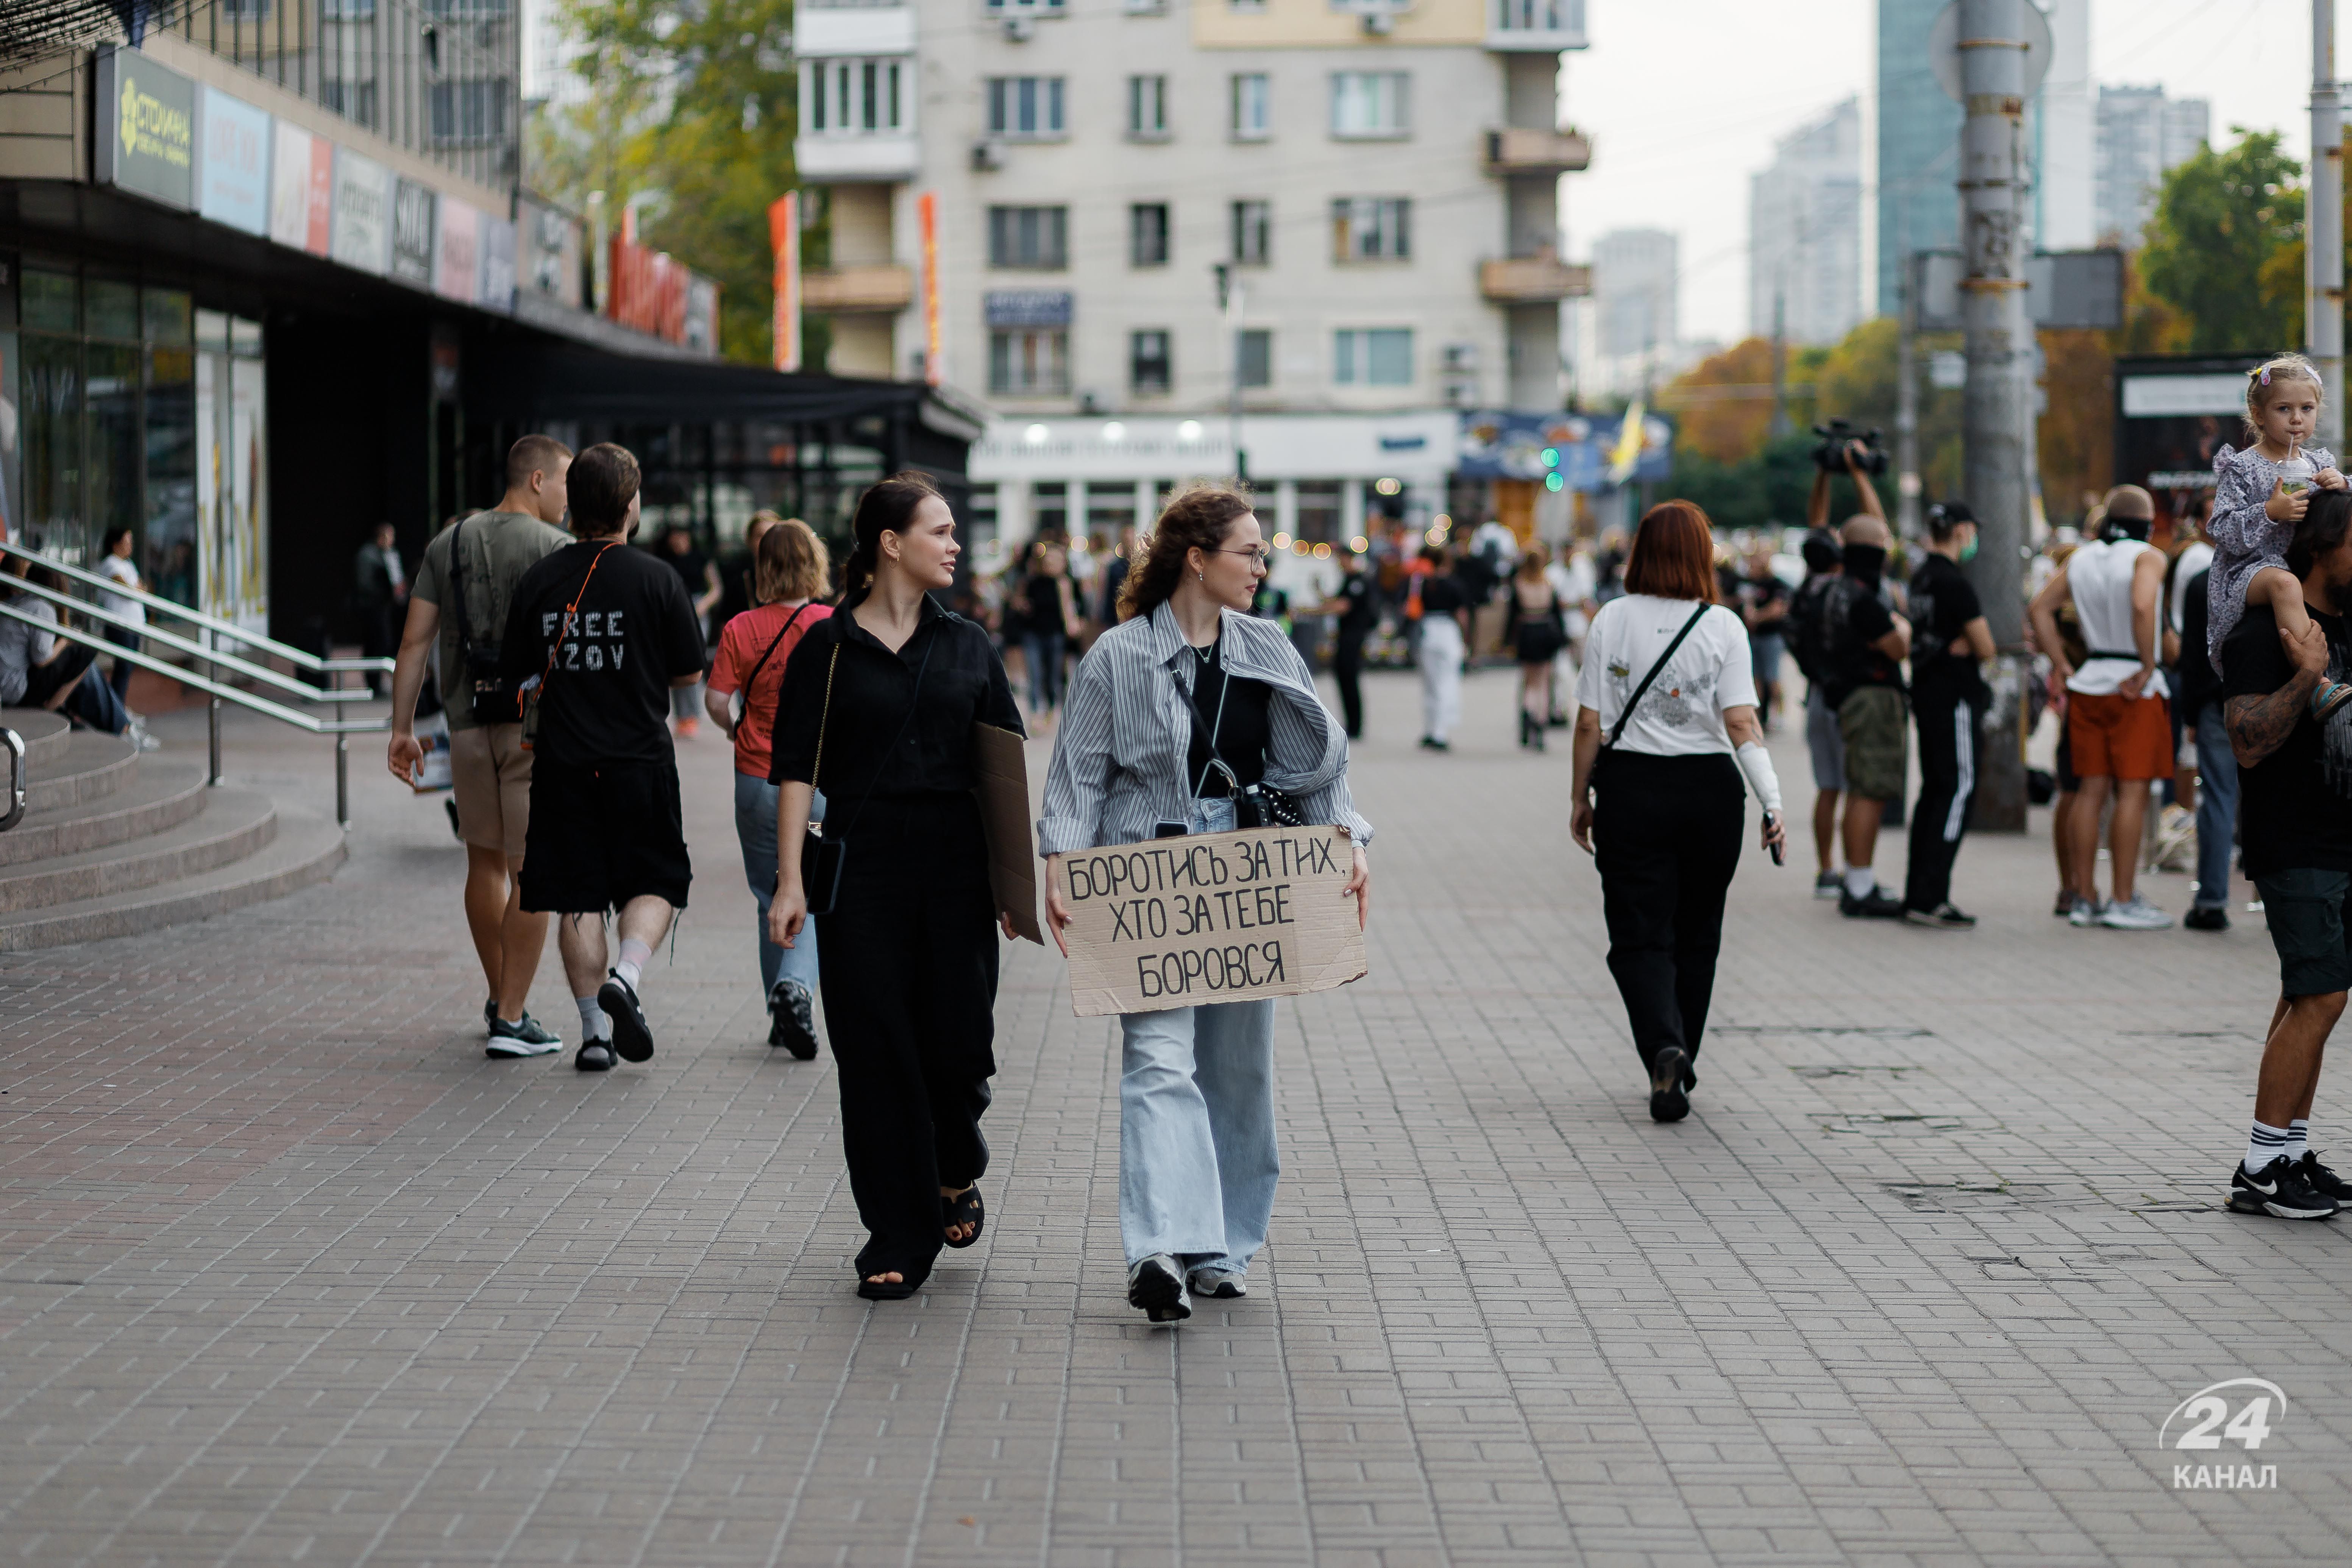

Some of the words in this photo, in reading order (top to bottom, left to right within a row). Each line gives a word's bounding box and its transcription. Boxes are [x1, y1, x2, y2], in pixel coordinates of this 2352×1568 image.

[543, 610, 624, 637] FREE
[1067, 846, 1228, 901] БОРОТИСЬ
[1235, 840, 1271, 882] ЗА
[1109, 898, 1167, 942] ХТО
[1176, 894, 1214, 936] ЗА
[1214, 885, 1294, 930] ТЕБЕ
[1138, 941, 1285, 998] БОРОВСЯ
